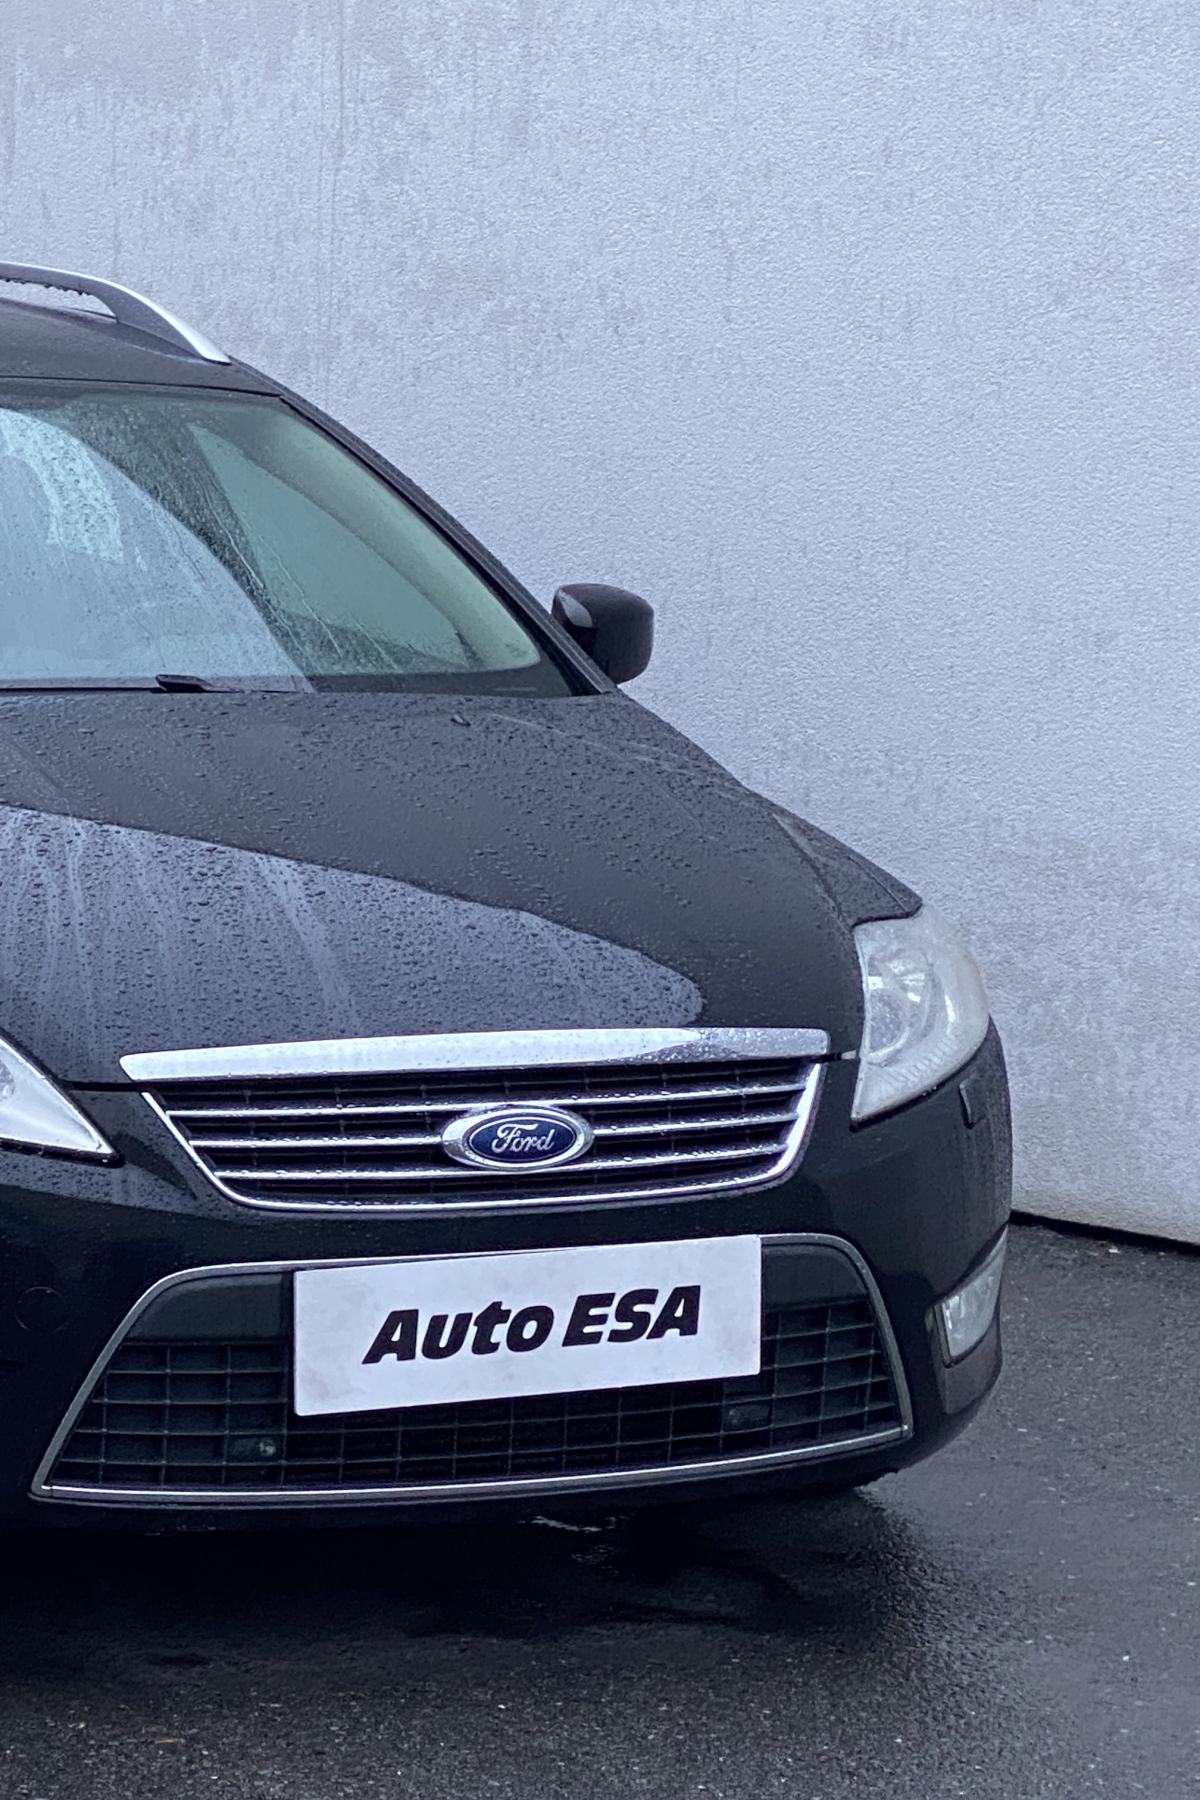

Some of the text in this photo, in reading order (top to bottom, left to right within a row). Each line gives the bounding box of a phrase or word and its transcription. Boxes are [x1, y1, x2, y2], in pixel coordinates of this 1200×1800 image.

[491, 1123, 555, 1153] Ford
[361, 1285, 701, 1364] Auto ESA
